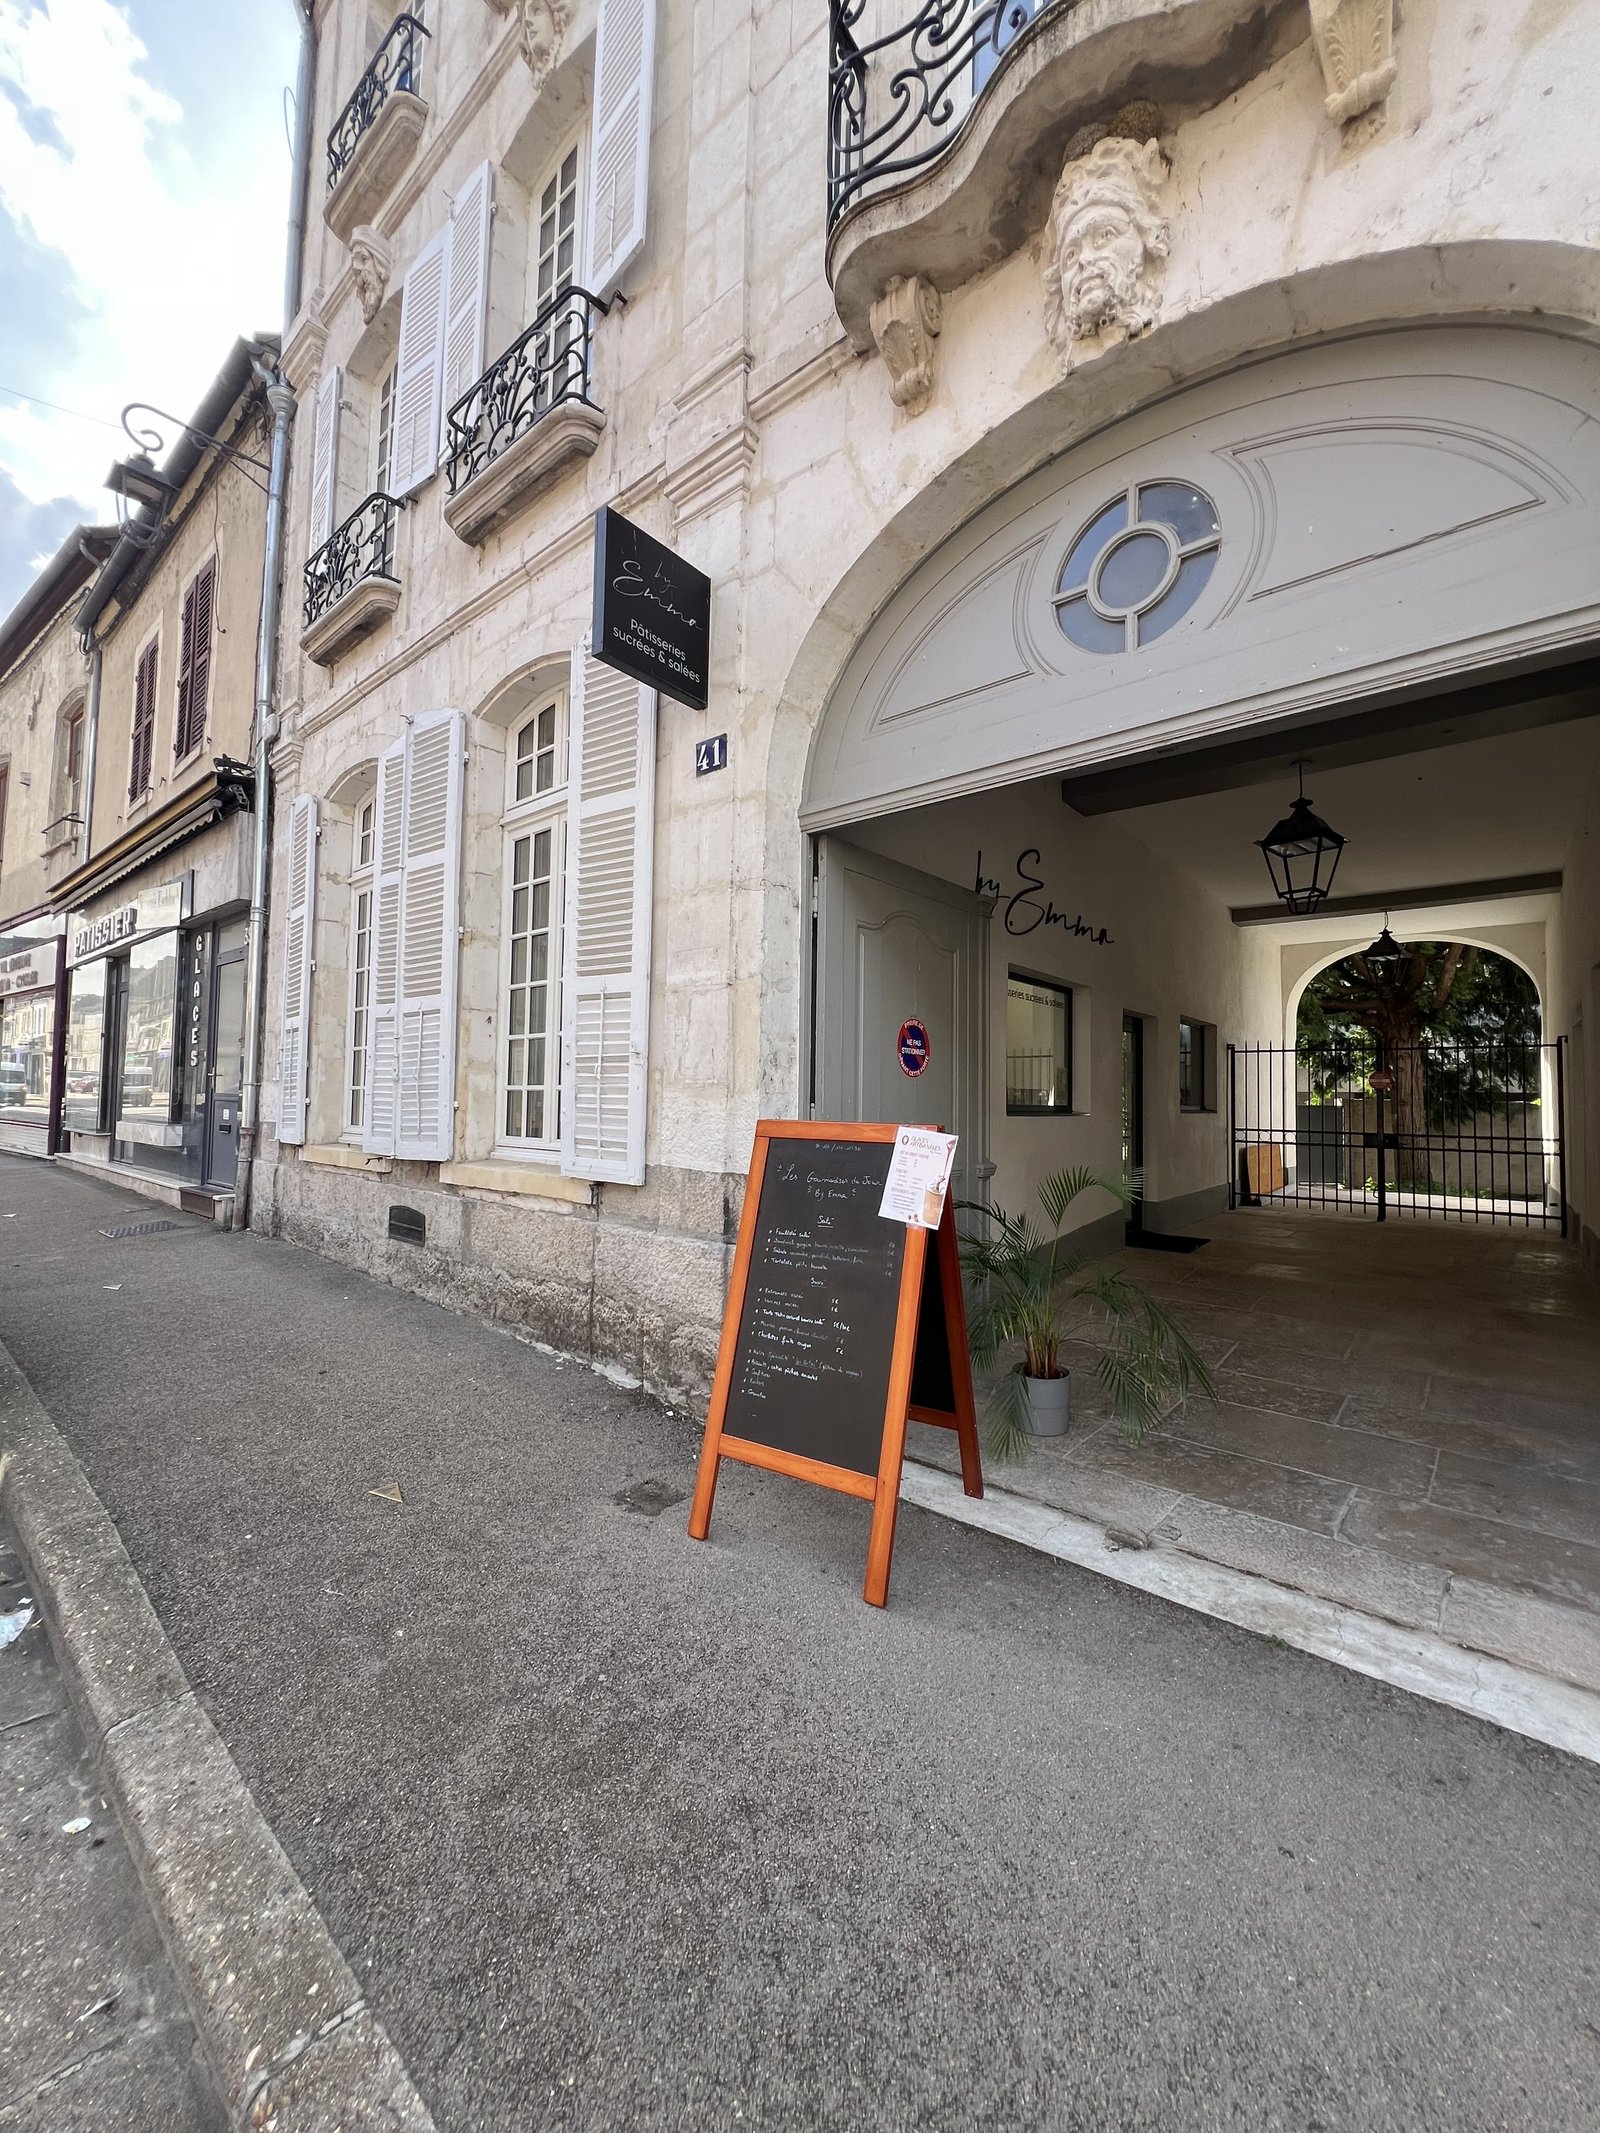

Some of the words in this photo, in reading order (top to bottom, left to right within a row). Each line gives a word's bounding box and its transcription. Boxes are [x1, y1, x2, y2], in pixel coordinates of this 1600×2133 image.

[612, 560, 704, 631] Emma
[654, 560, 678, 594] by
[612, 626, 656, 658] sucrées
[658, 650, 666, 664] &
[668, 659, 701, 683] salées
[630, 618, 686, 661] Pâtisseries
[697, 739, 721, 771] 41
[974, 849, 1010, 916] by
[1004, 848, 1115, 946] Emma
[74, 907, 138, 958] PATISSIER
[189, 934, 204, 1068] GLACES
[901, 1046, 926, 1056] STATIONNER
[906, 1038, 913, 1046] NE
[912, 1039, 922, 1047] PAS
[814, 1187, 825, 1202] By
